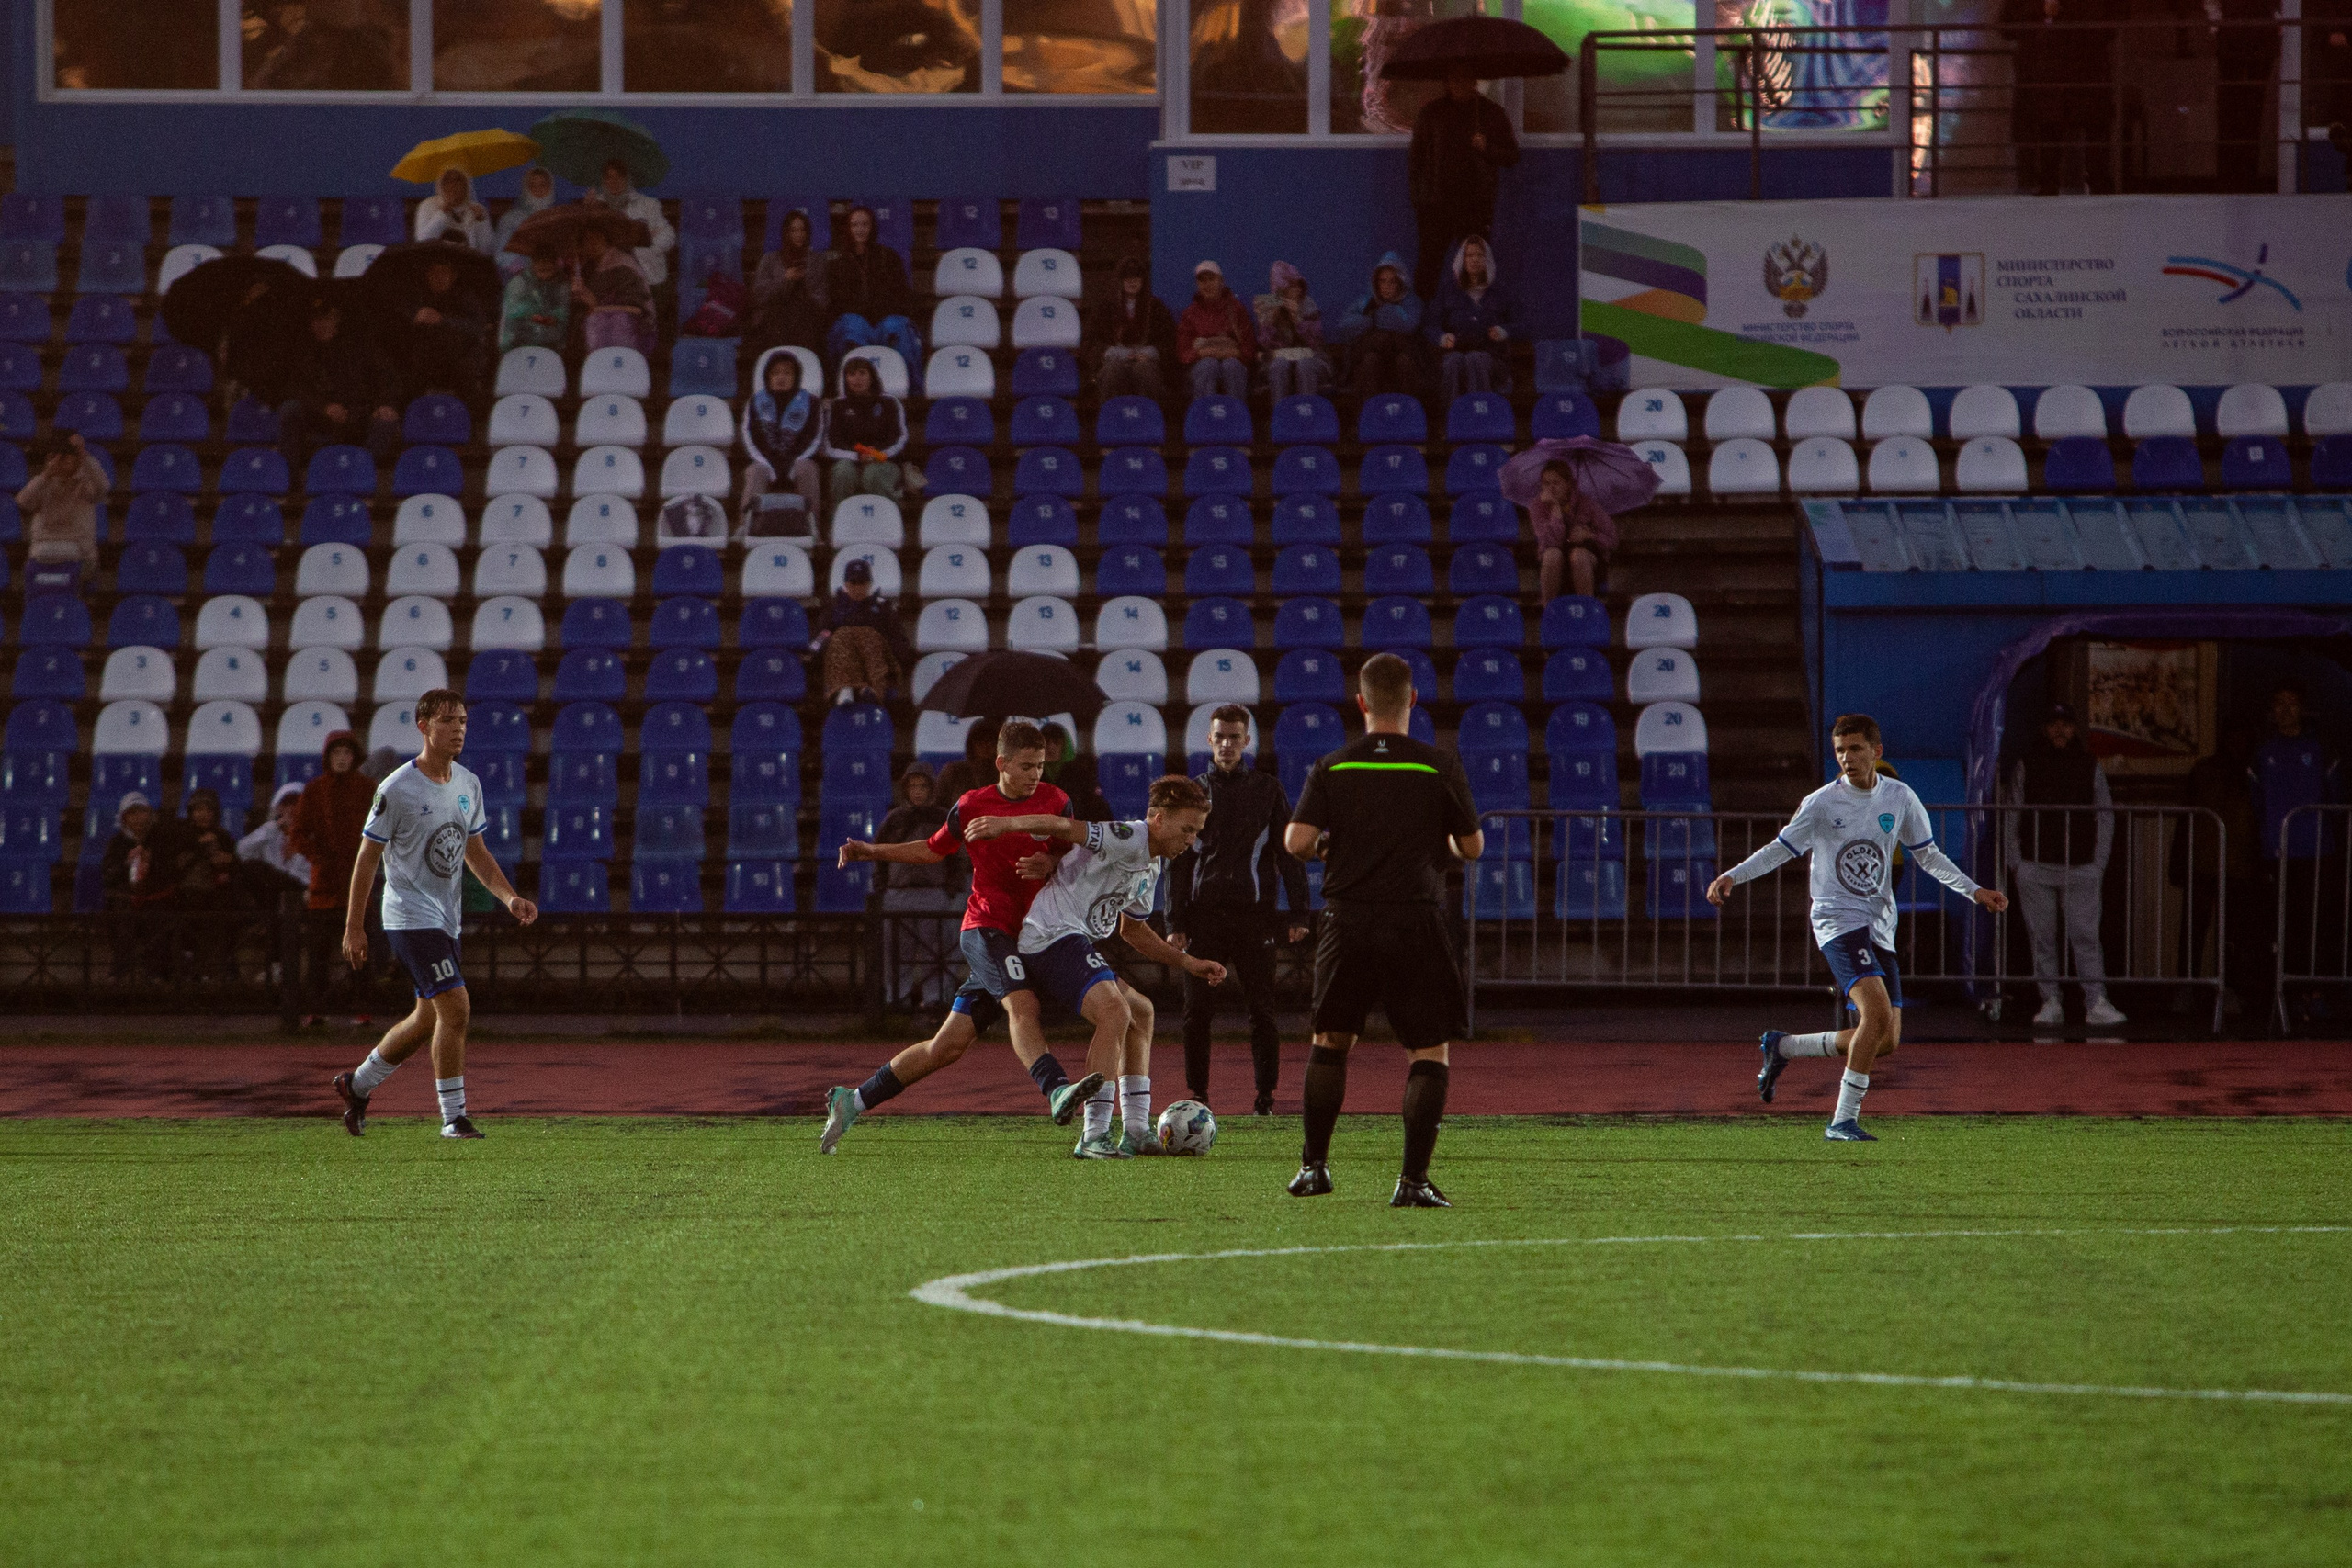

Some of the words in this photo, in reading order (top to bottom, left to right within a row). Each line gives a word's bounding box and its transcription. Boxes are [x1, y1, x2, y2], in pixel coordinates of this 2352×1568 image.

[1181, 159, 1204, 170] VIP
[962, 258, 977, 270] 12
[1041, 258, 1057, 271] 13
[1996, 258, 2114, 271] МИНИСТЕРСТВО
[1996, 276, 2053, 288] СПОРТА
[2014, 288, 2127, 303] САХАЛИНСКОЙ
[959, 306, 974, 318] 12
[1040, 306, 1055, 319] 13
[2014, 307, 2083, 319] ОБЛАСТИ
[527, 355, 537, 367] 7
[614, 357, 623, 368] 8
[956, 355, 970, 367] 12
[521, 405, 530, 417] 7
[608, 404, 618, 416] 8
[696, 405, 707, 417] 9
[1646, 400, 1662, 412] 20
[518, 456, 527, 468] 7
[605, 455, 615, 467] 8
[694, 455, 704, 467] 9
[1647, 450, 1666, 463] 20
[422, 505, 433, 517] 6
[514, 505, 523, 517] 7
[600, 504, 609, 517] 8
[862, 505, 874, 516] 11
[950, 504, 965, 517] 12
[332, 553, 342, 565] 5
[417, 553, 428, 566] 6
[509, 554, 518, 566] 7
[596, 555, 606, 568] 8
[773, 555, 787, 567] 10
[948, 554, 963, 567] 12
[1037, 554, 1052, 567] 13
[230, 607, 241, 618] 4
[327, 607, 336, 620] 5
[410, 606, 420, 618] 6
[503, 608, 513, 620] 7
[945, 608, 959, 620] 12
[1038, 606, 1053, 619] 13
[1124, 607, 1138, 619] 14
[1654, 605, 1671, 618] 20
[137, 656, 146, 669] 3
[320, 660, 329, 671] 5
[404, 659, 415, 671] 6
[1126, 661, 1141, 672] 14
[1217, 659, 1231, 671] 15
[1657, 659, 1675, 671] 20
[130, 711, 140, 726] 3
[221, 713, 232, 724] 4
[312, 713, 322, 726] 5
[400, 711, 410, 723] 6
[1126, 713, 1142, 725] 14
[1665, 712, 1682, 725] 20
[1858, 949, 1871, 965] 3
[431, 959, 455, 982] 10
[1005, 955, 1025, 980] 6
